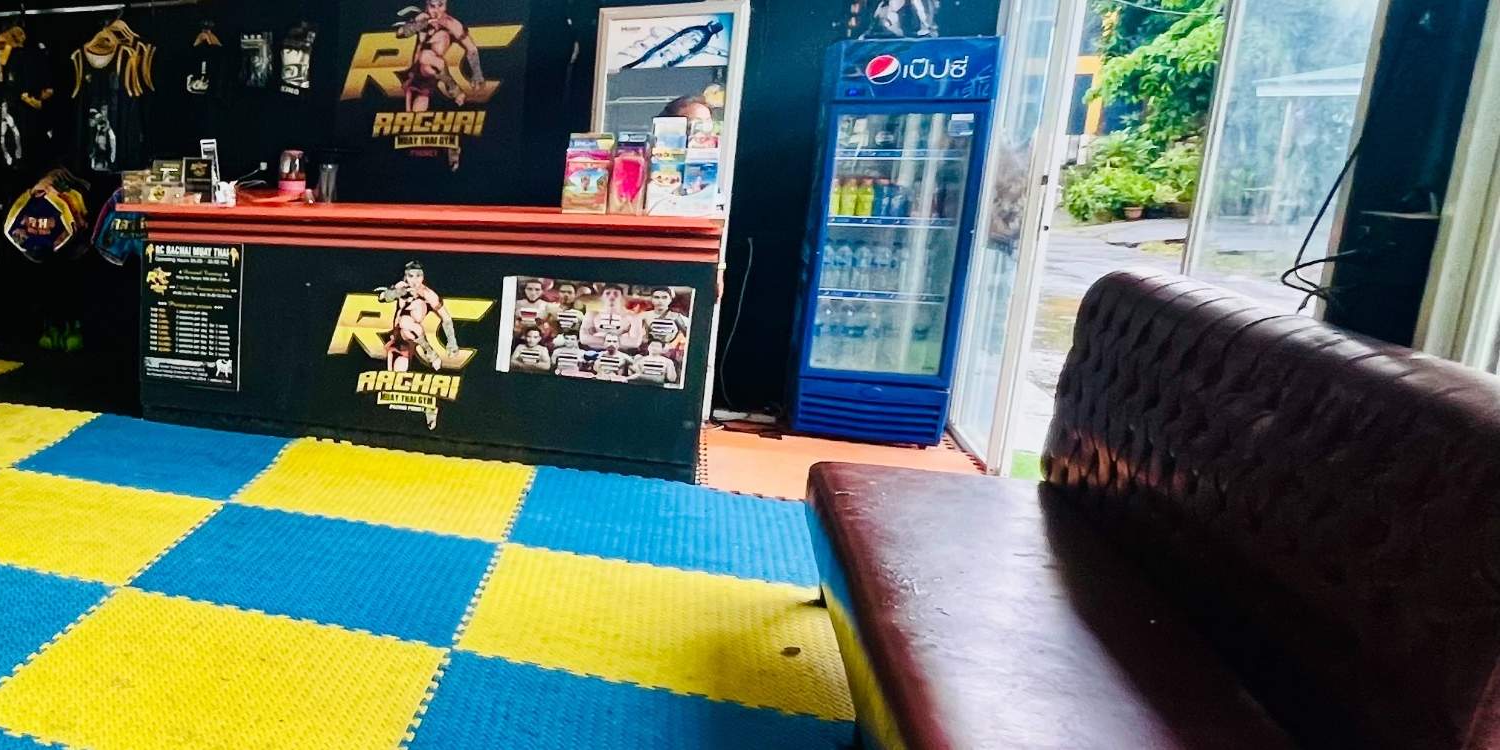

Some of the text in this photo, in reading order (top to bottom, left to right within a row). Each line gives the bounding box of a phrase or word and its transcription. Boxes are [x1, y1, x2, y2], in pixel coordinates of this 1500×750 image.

[420, 136, 438, 145] THAI
[327, 293, 494, 369] RC
[401, 394, 417, 403] THAI
